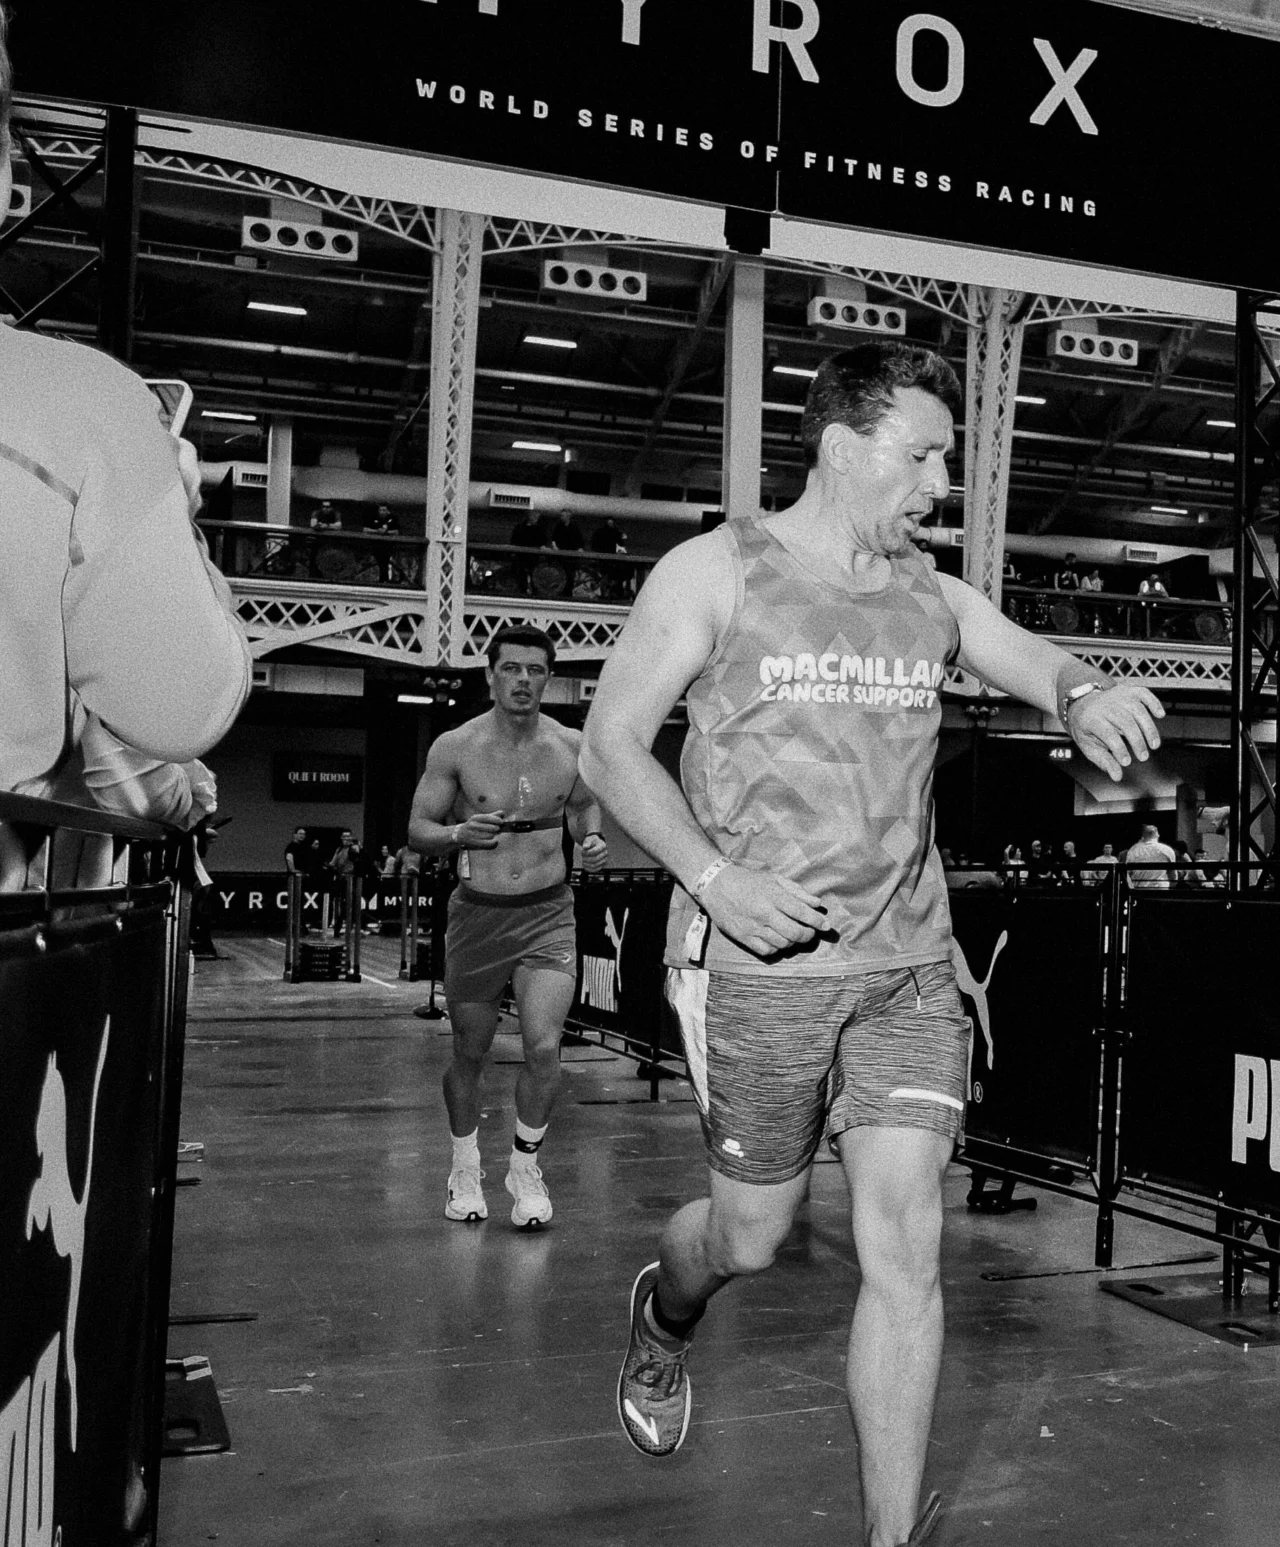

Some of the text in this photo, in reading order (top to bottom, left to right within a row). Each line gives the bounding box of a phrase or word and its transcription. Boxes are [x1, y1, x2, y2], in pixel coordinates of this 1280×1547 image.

[415, 78, 1096, 217] WORLD SERIES OF FITNESS RACING
[760, 683, 937, 708] CANCER SUPPORT
